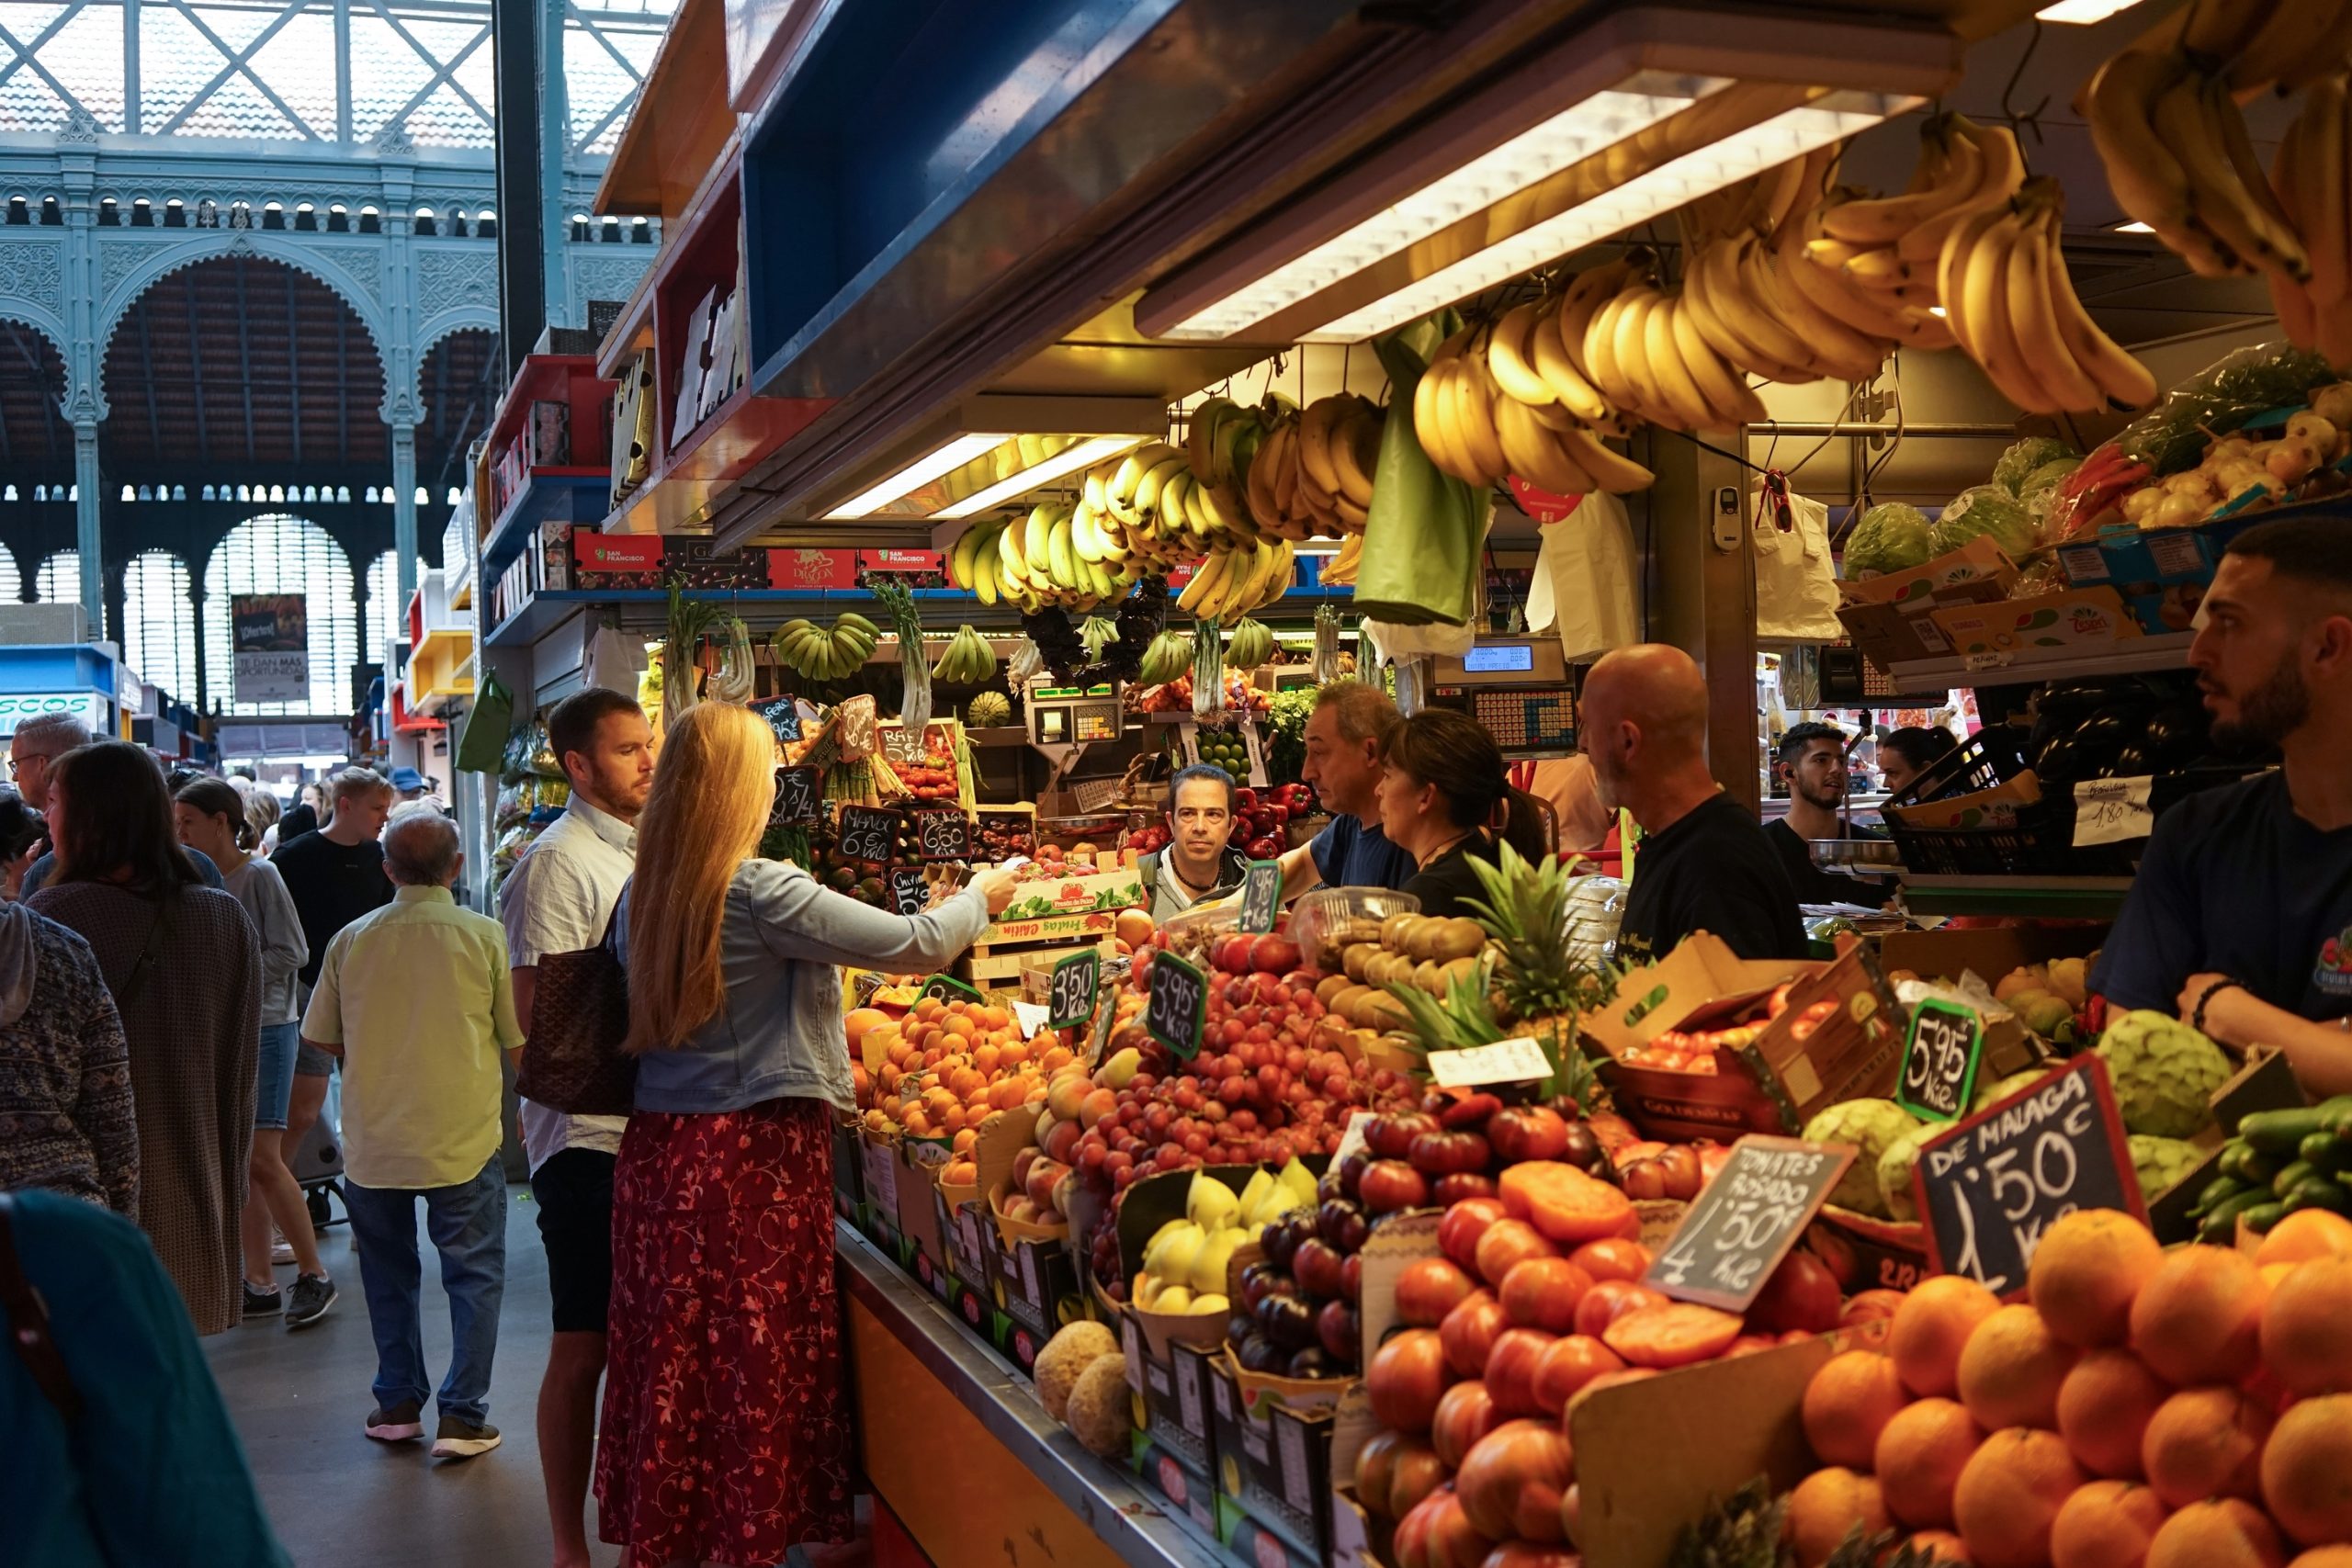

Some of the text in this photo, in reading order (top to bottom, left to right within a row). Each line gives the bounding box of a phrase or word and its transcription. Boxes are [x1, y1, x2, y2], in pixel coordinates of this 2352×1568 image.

[842, 831, 865, 854] 6
[1044, 919, 1080, 932] Frutas
[1930, 1069, 2086, 1178] DE MALAGA
[1738, 1147, 1825, 1177] TOMATES
[1728, 1172, 1810, 1206] ROSADO
